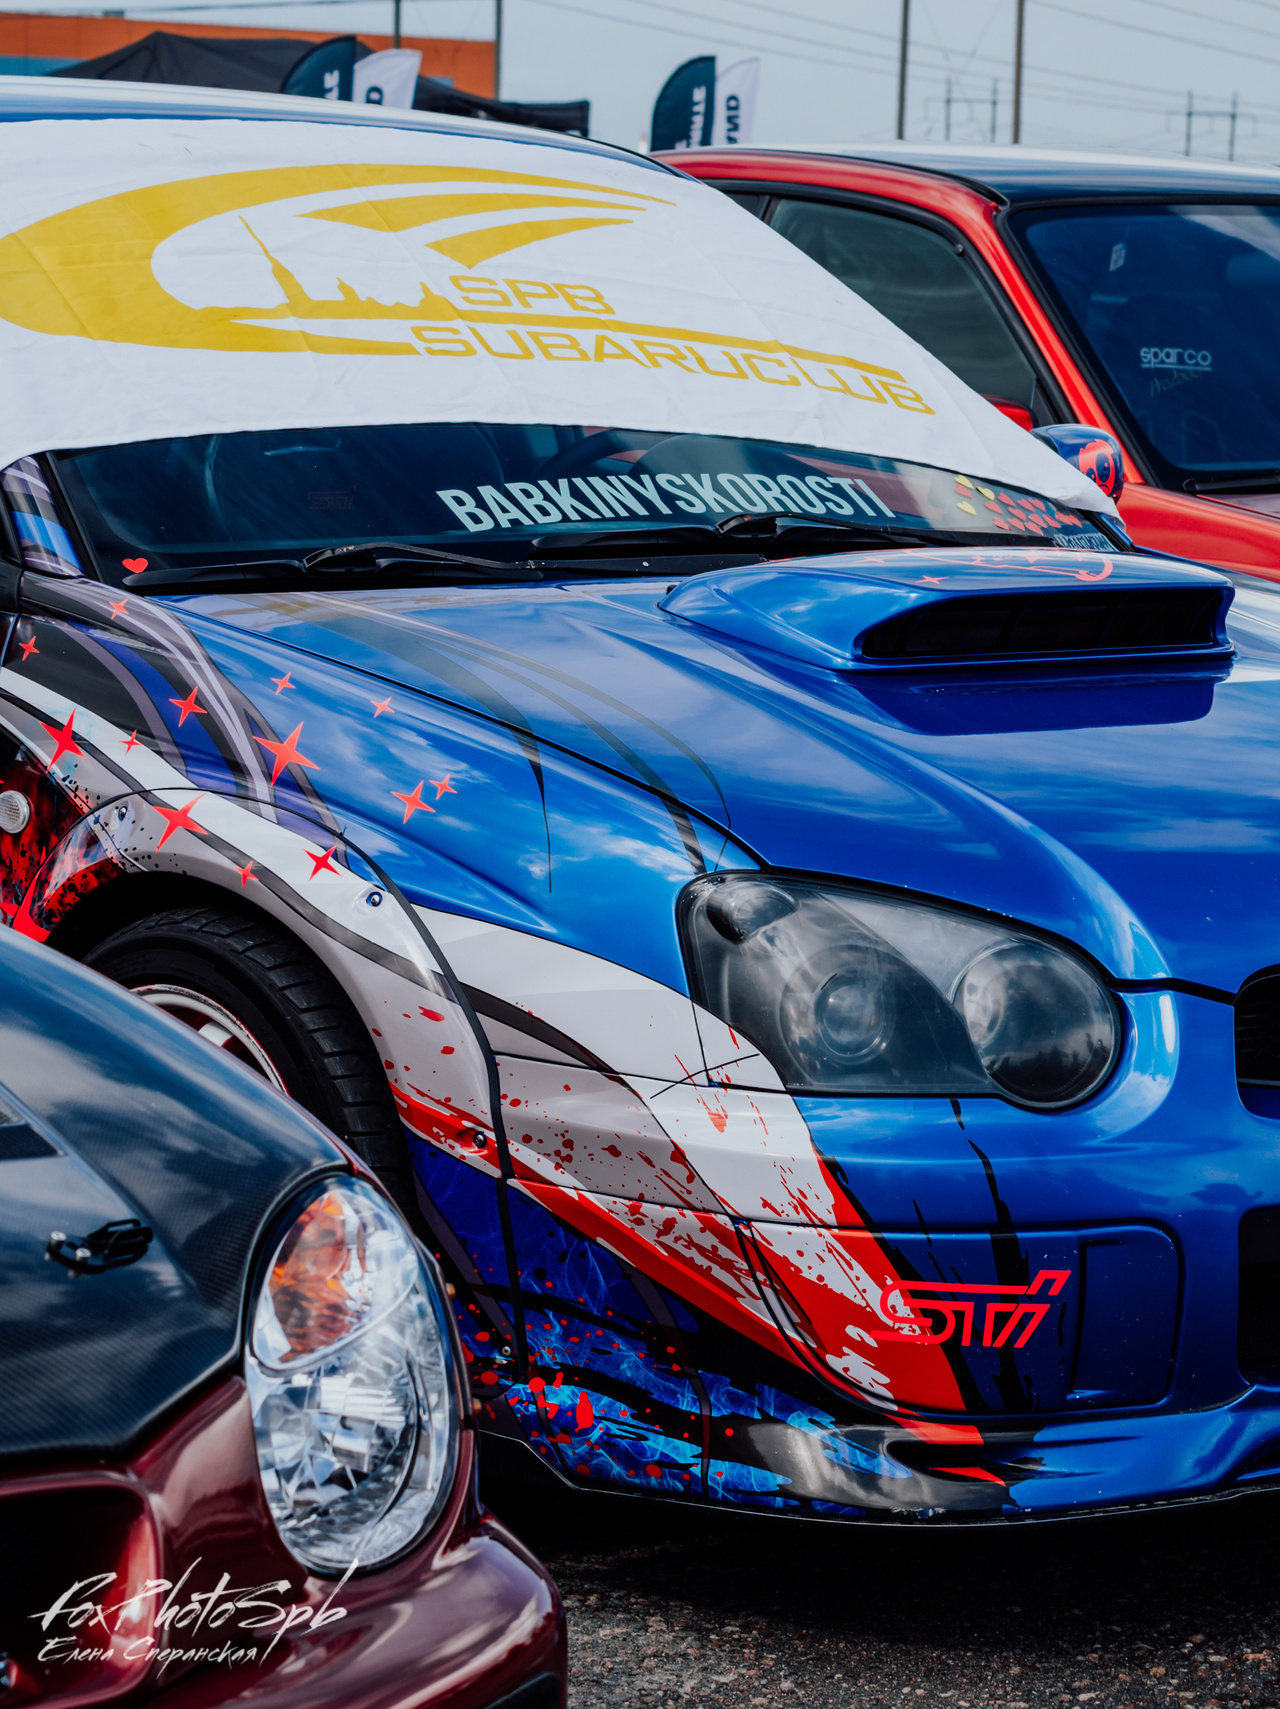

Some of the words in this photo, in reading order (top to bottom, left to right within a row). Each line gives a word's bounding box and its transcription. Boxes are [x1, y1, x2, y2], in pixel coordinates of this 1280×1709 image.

[449, 275, 616, 315] SPB
[411, 326, 936, 416] SUBARUCLUB
[1140, 346, 1212, 369] sparco
[437, 472, 897, 533] BABKINYSKOROSTI
